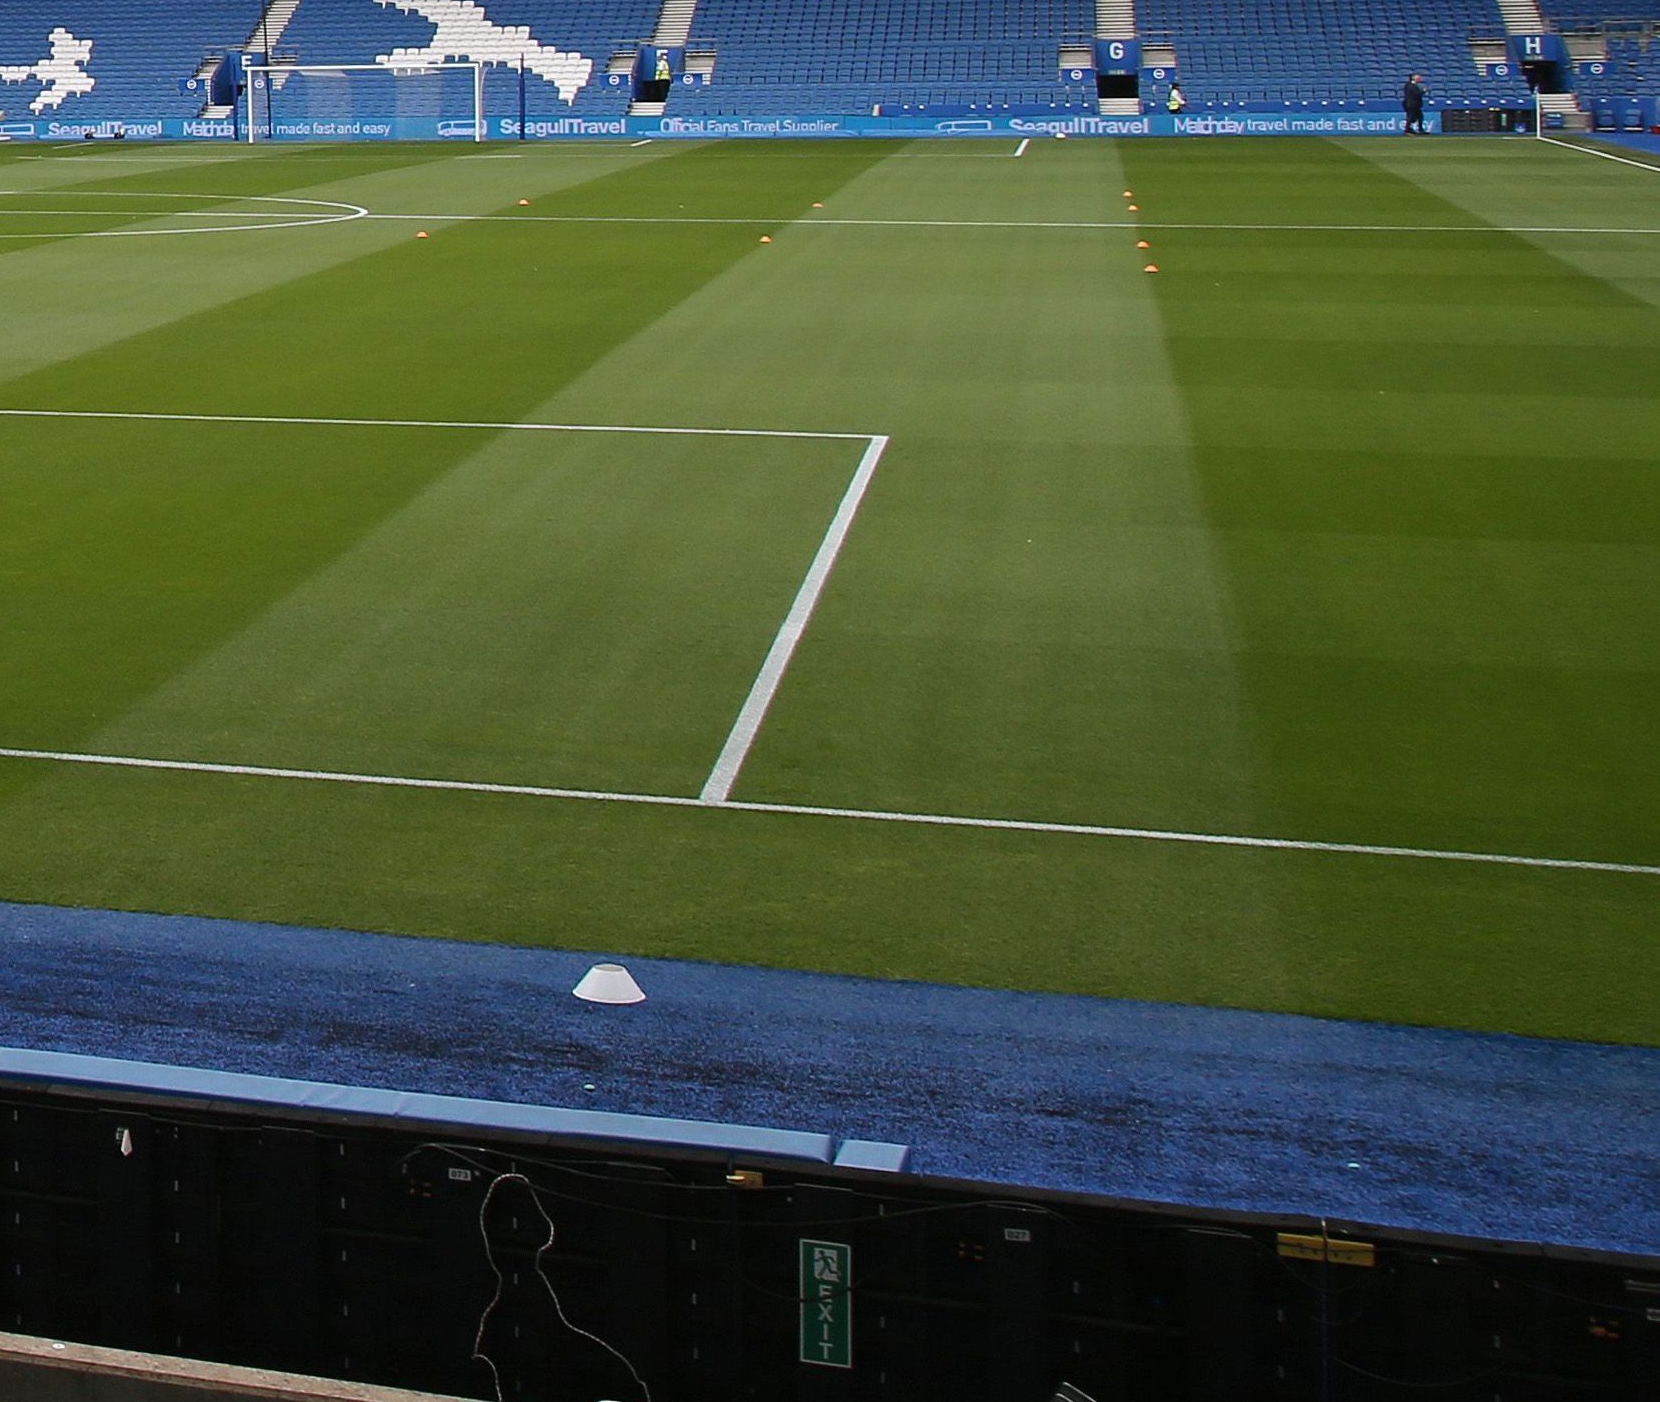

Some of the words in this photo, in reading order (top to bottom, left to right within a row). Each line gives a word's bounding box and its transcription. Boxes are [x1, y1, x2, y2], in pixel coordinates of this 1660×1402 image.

[1109, 42, 1123, 59] G
[1525, 37, 1540, 54] H
[48, 122, 163, 136] SeagullTravel
[276, 124, 311, 135] made
[312, 123, 336, 135] fast
[337, 123, 361, 135] and
[362, 125, 391, 138] easy
[500, 118, 626, 136] SeagullTravel
[660, 117, 705, 132] Official
[707, 120, 739, 132] Fans
[741, 119, 782, 132] Travel
[783, 119, 839, 132] Supplier
[1008, 118, 1149, 133] SeagullTravel
[1247, 119, 1289, 131] travel
[1292, 119, 1334, 131] made
[1336, 118, 1365, 131] fast
[1367, 118, 1397, 131] and
[818, 1284, 833, 1360] EXIT
